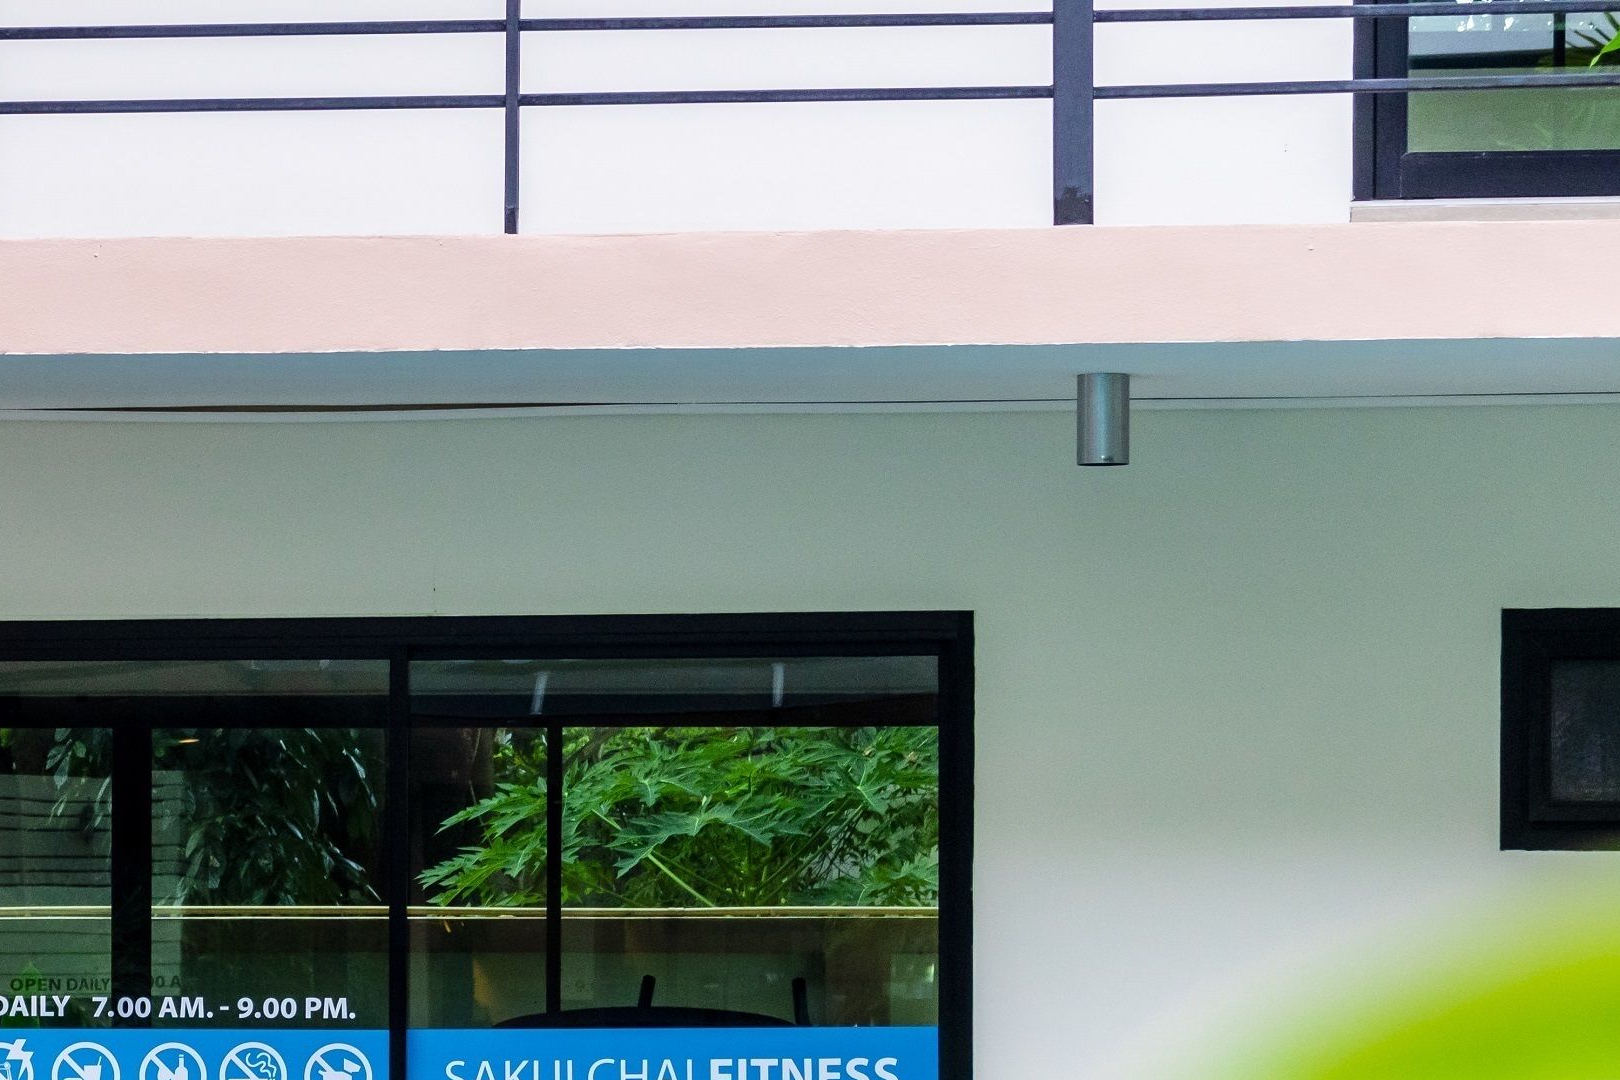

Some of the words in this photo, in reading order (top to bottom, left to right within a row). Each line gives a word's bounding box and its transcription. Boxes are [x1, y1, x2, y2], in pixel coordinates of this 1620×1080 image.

[92, 995, 151, 1019] 7.00
[237, 996, 297, 1020] 9.00
[305, 997, 357, 1021] PM.
